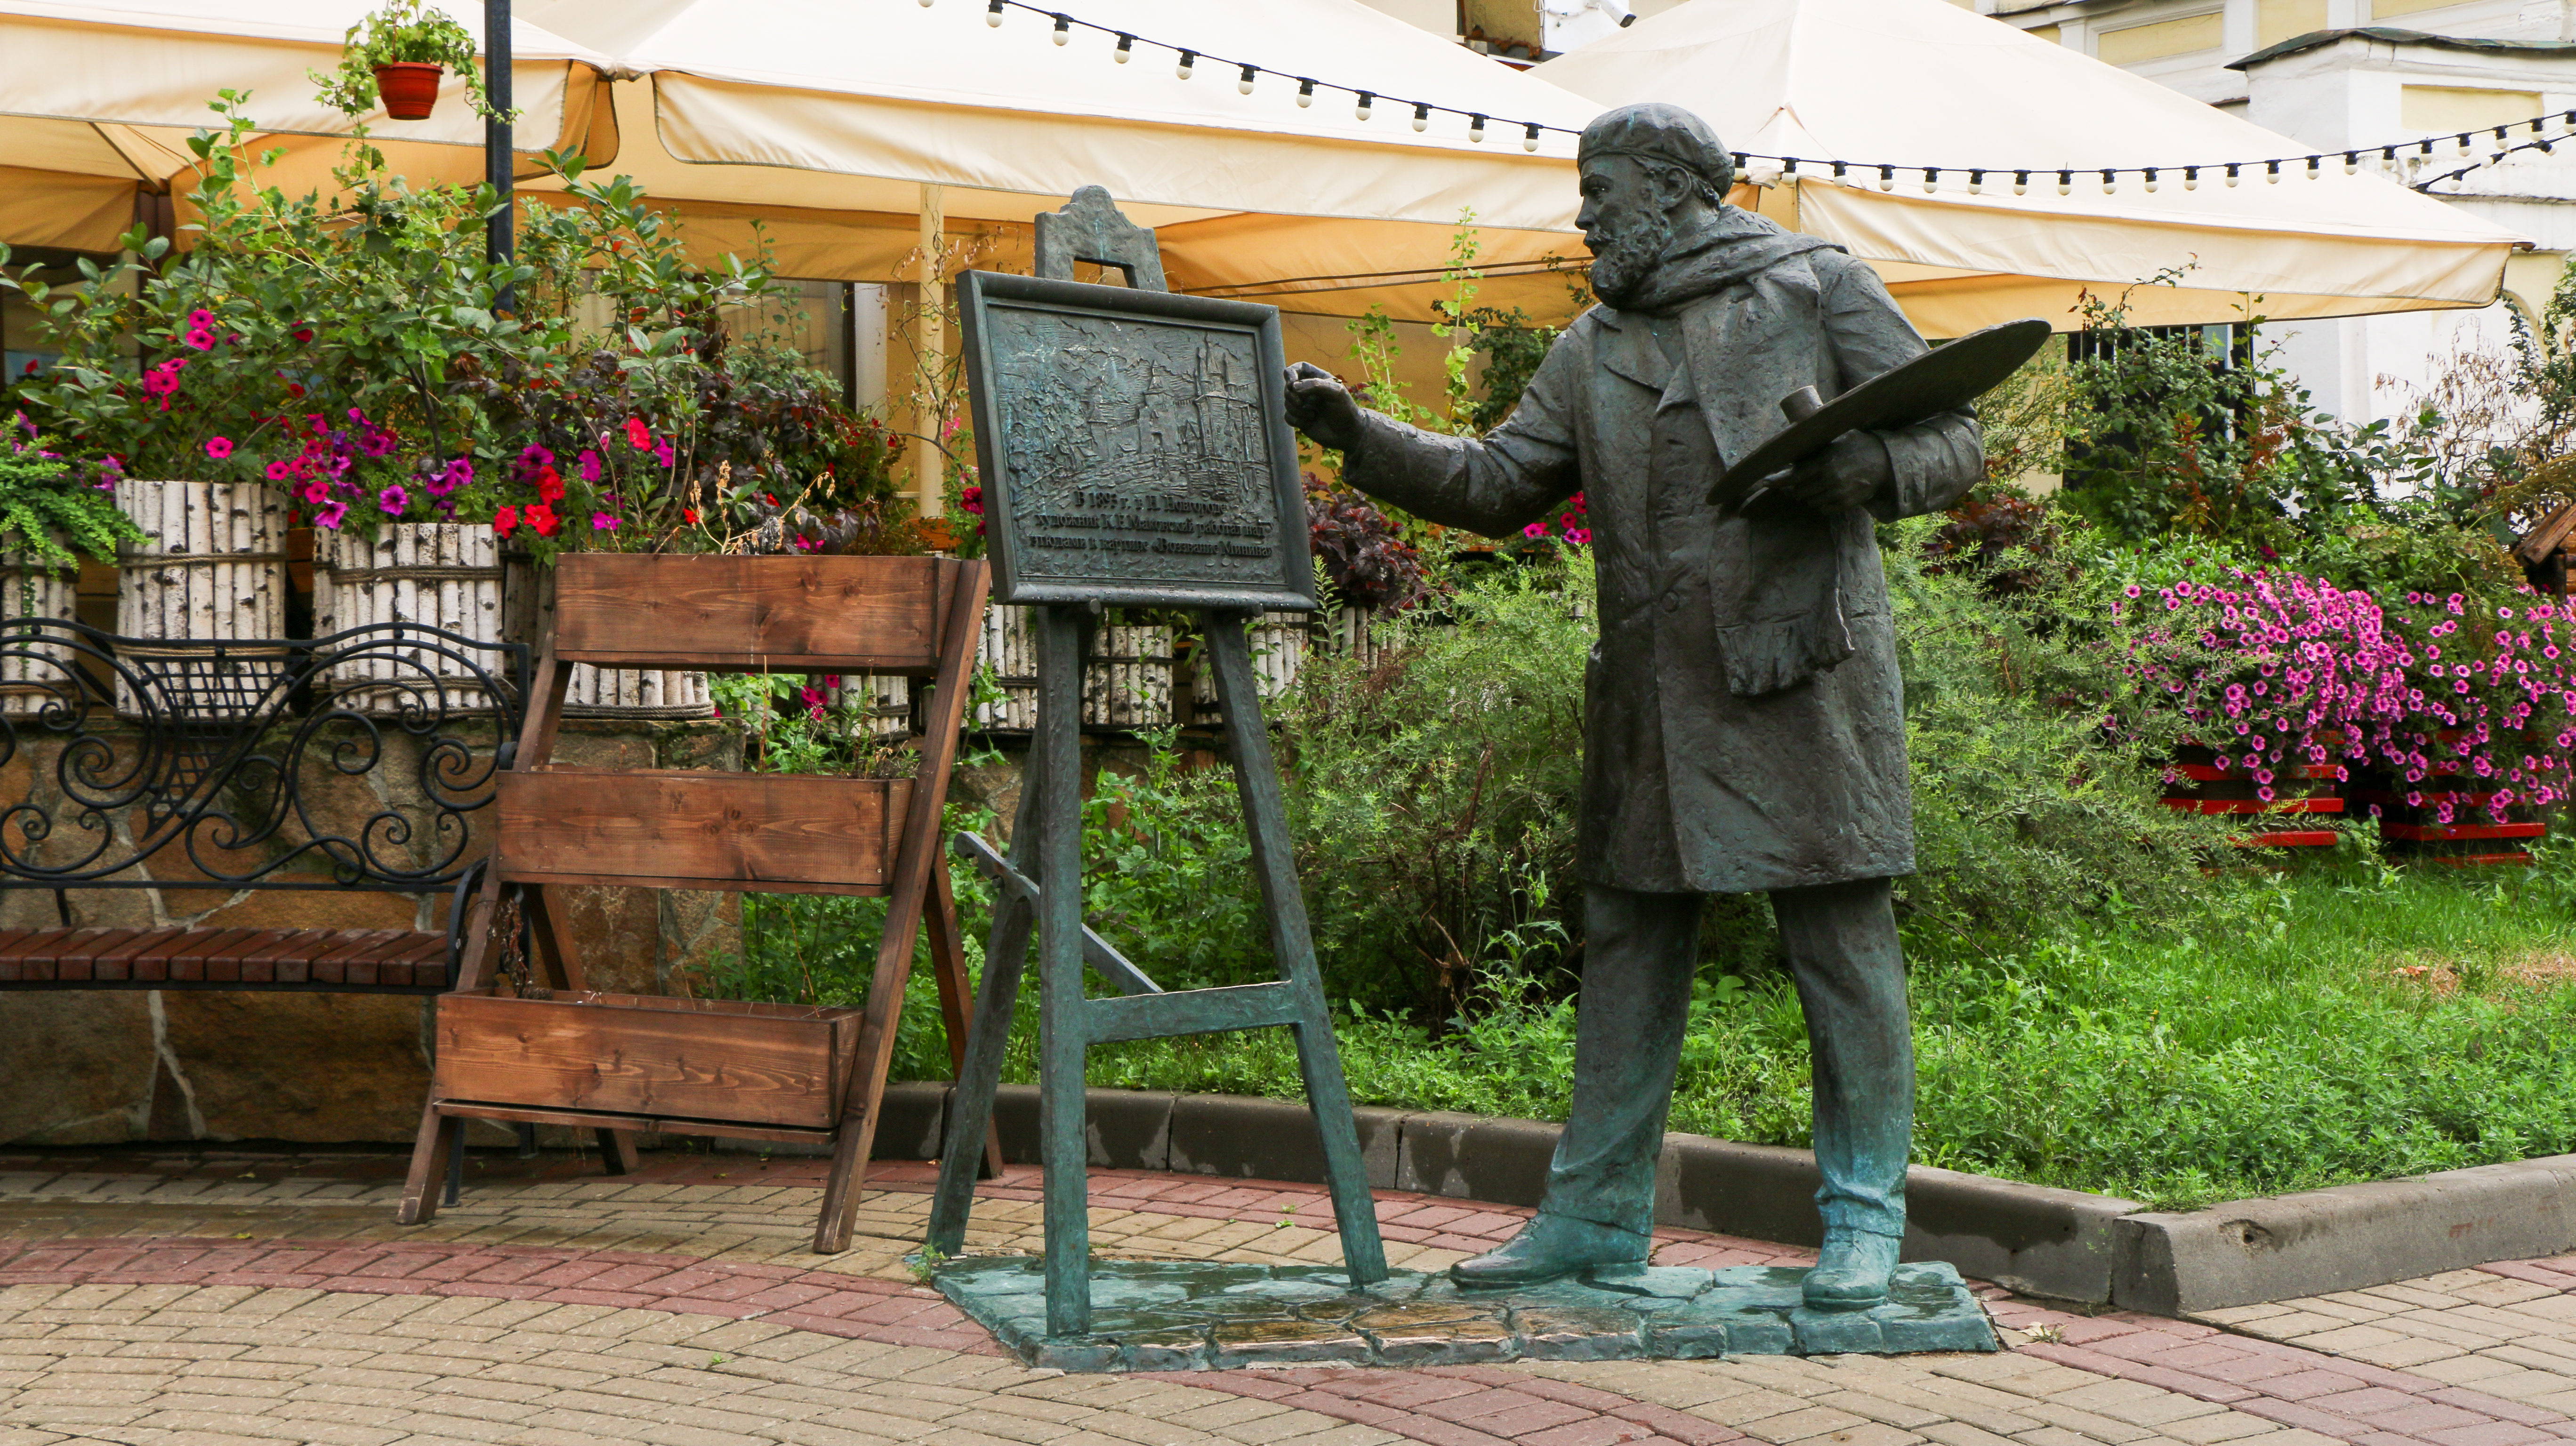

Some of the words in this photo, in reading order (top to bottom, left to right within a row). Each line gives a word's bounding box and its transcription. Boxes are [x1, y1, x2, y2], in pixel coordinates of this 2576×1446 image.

[1074, 491, 1085, 506] В
[1163, 496, 1228, 517] Новгороде
[1034, 514, 1100, 530] художник
[1196, 521, 1241, 538] работал
[1242, 524, 1266, 539] над
[1030, 536, 1087, 549] этюдами
[1088, 537, 1097, 549] к
[1099, 539, 1150, 554] картине
